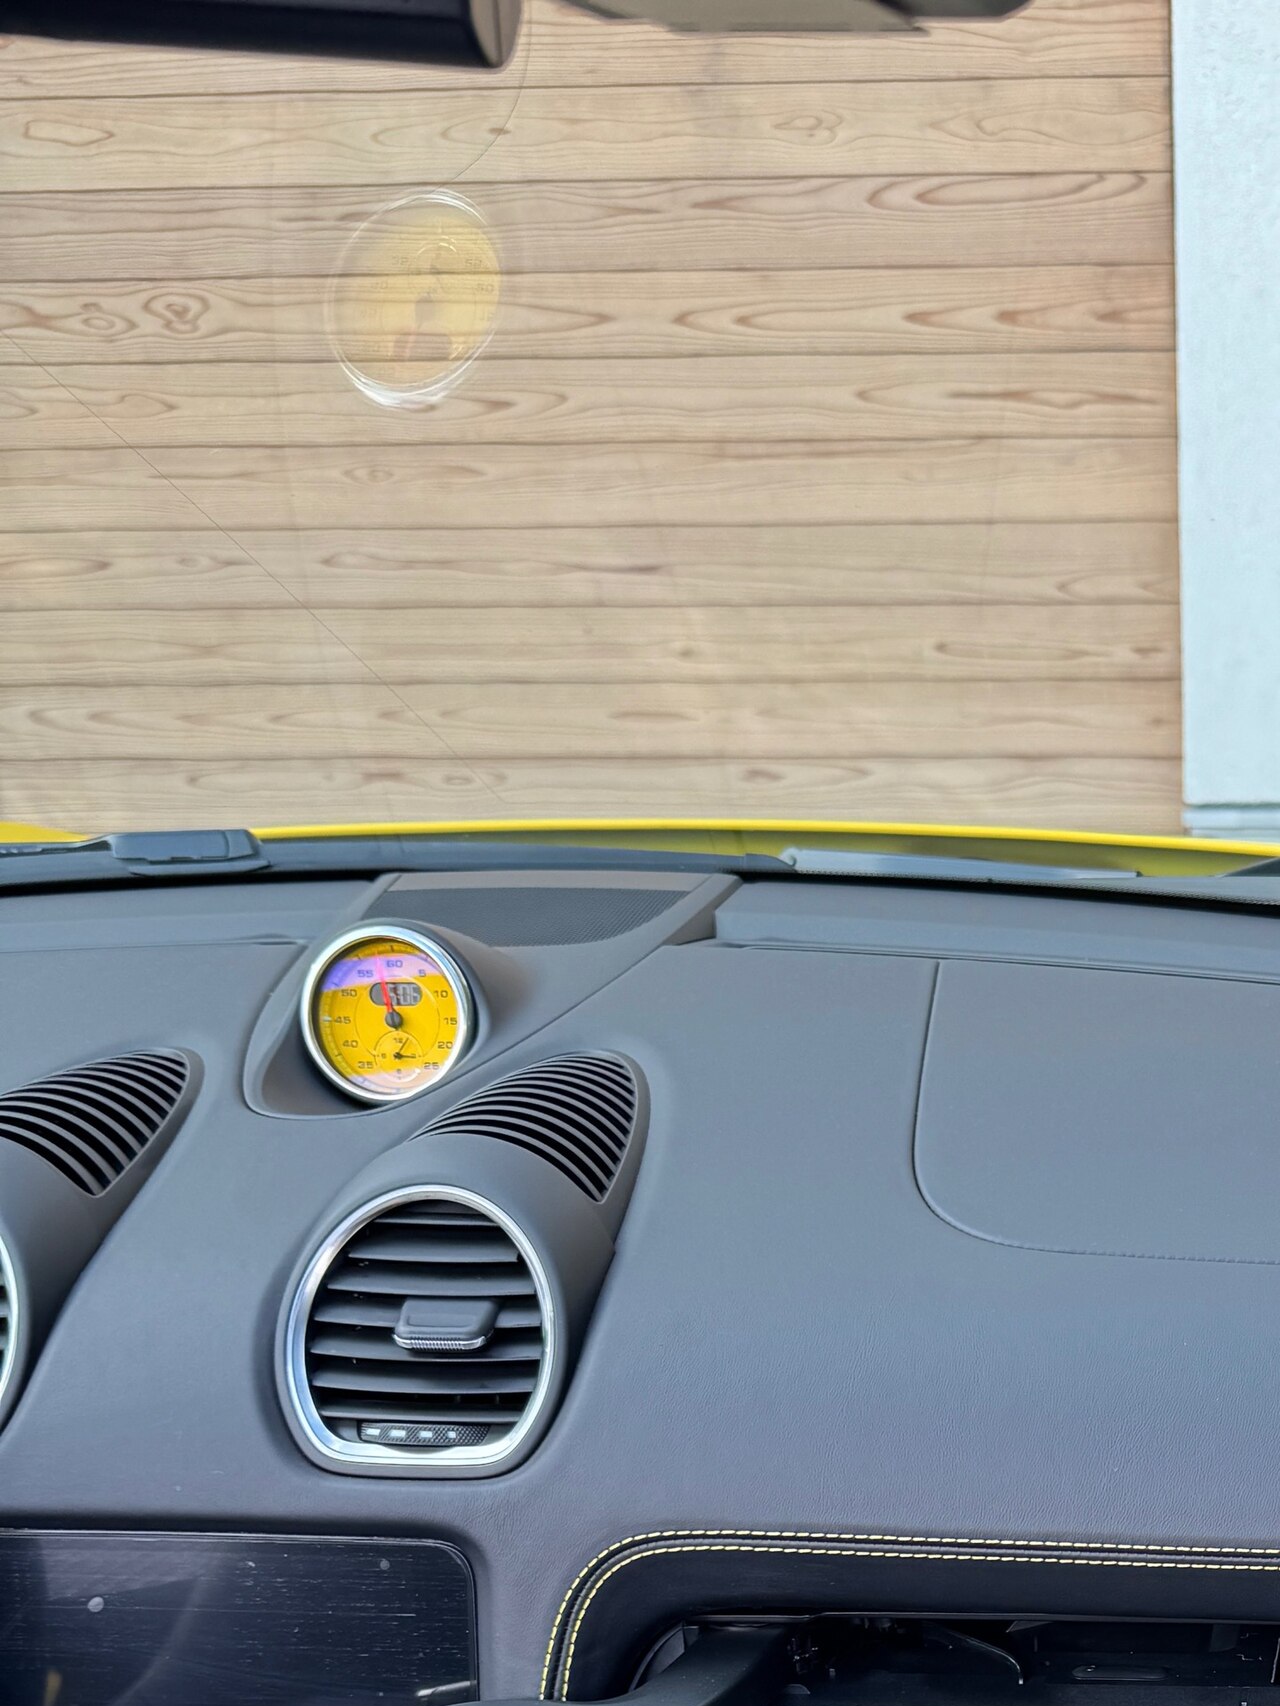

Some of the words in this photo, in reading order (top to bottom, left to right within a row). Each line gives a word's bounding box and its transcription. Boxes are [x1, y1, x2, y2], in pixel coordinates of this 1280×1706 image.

[386, 960, 403, 968] 60
[357, 969, 374, 978] 55
[418, 969, 427, 978] 5
[341, 988, 357, 997] 50
[434, 990, 449, 998] 10
[334, 1016, 351, 1024] 45
[443, 1017, 458, 1026] 15
[342, 1040, 358, 1048] 40
[437, 1041, 454, 1049] 20
[358, 1061, 374, 1069] 35
[424, 1062, 440, 1070] 25
